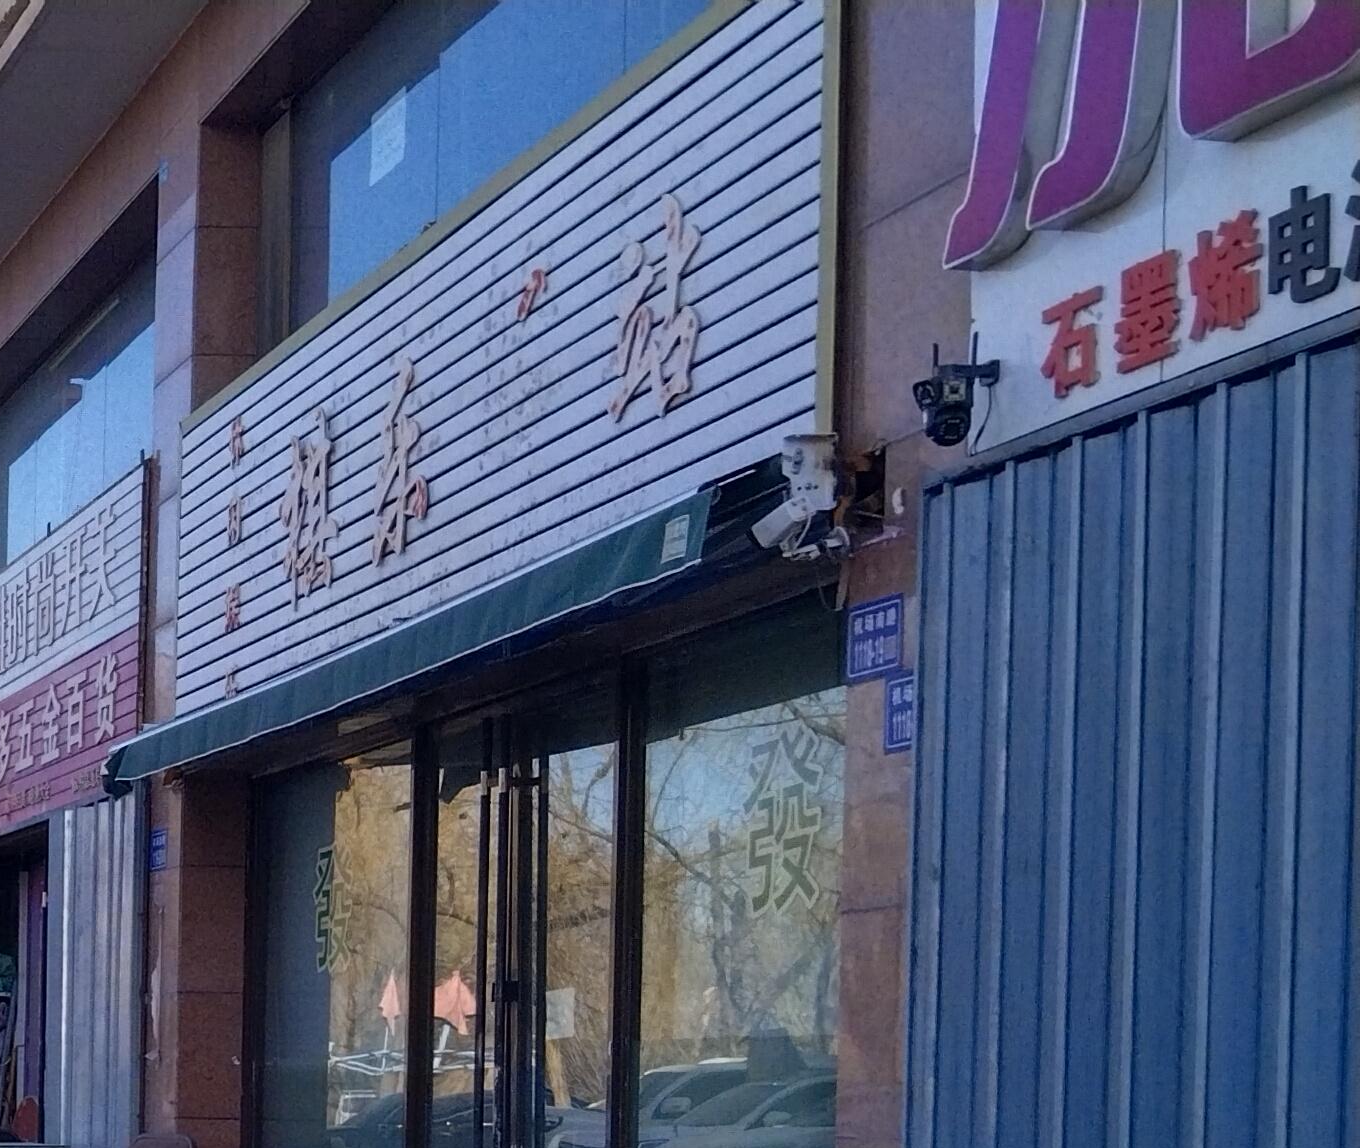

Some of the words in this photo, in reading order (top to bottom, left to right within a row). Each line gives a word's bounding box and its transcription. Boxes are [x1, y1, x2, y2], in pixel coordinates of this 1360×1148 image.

[1041, 160, 1360, 399] 石墨烯电
[313, 842, 354, 974] 發
[742, 725, 825, 918] 發
